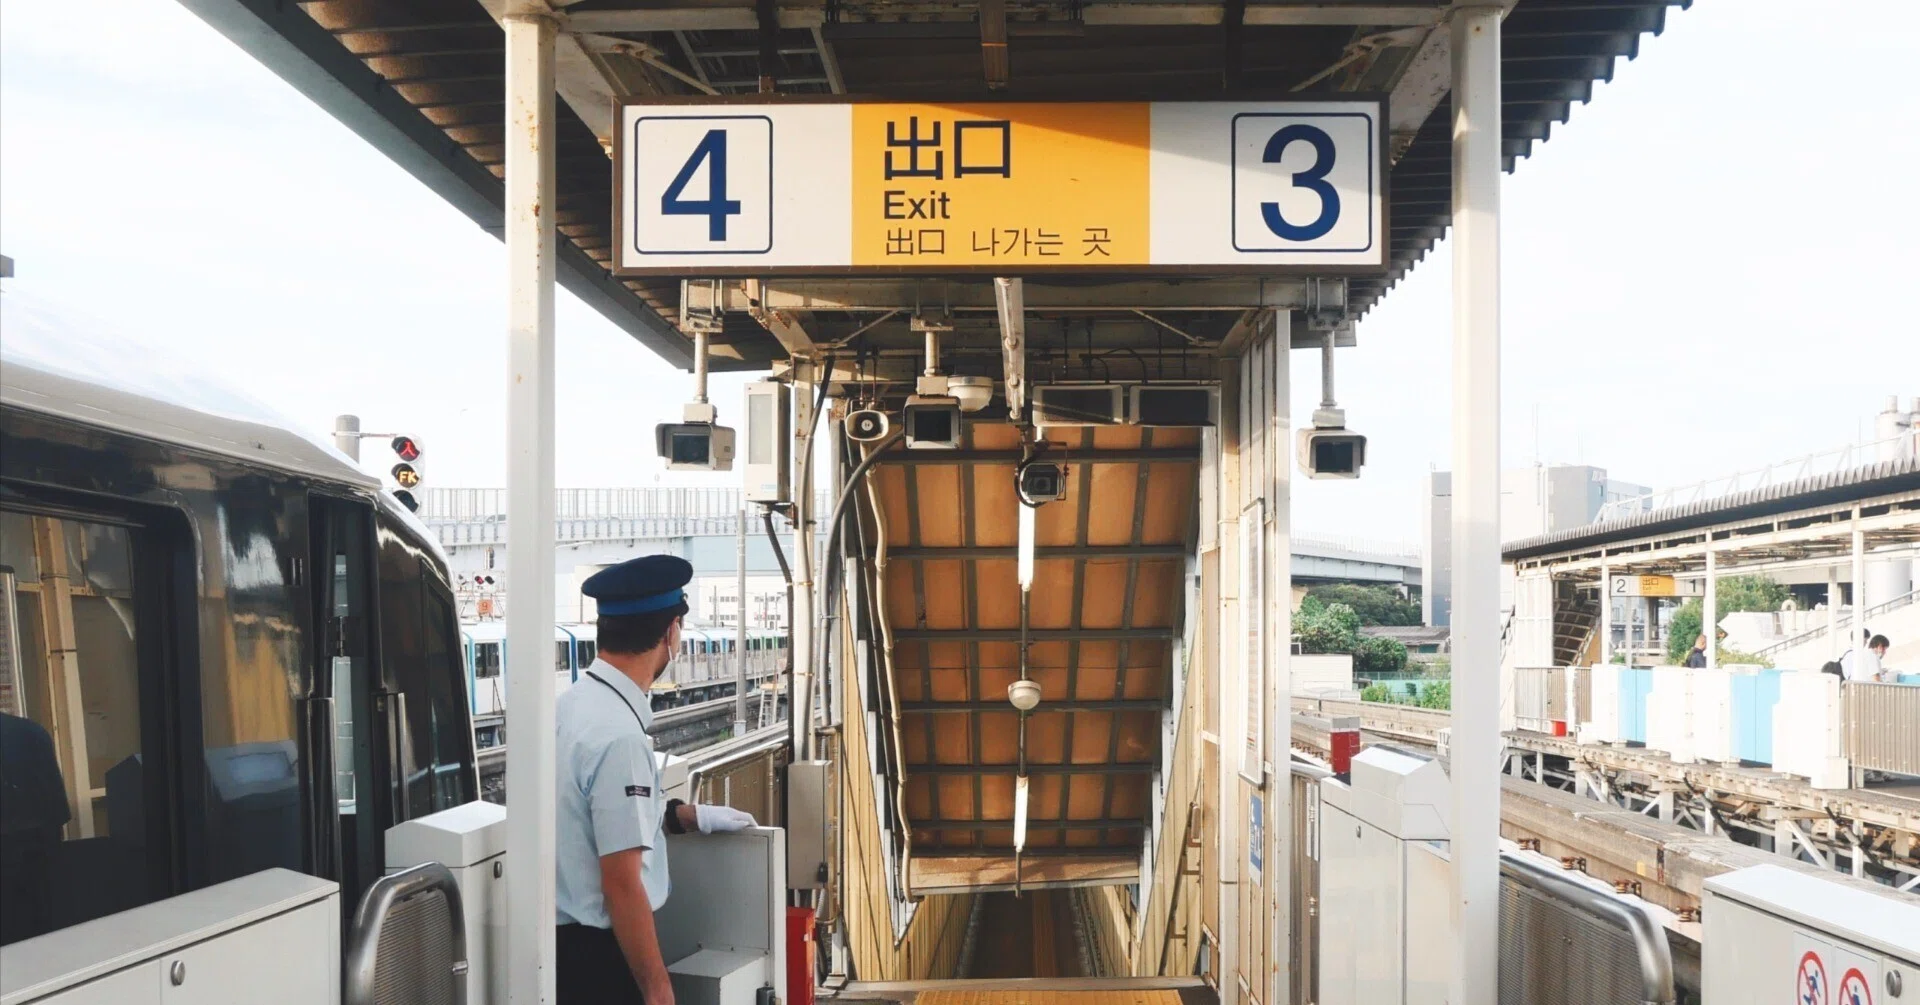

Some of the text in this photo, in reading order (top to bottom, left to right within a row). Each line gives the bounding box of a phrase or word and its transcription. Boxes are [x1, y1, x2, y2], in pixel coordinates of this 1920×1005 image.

[884, 116, 1011, 181] 出口
[661, 130, 741, 242] 4
[1260, 123, 1341, 242] 3
[884, 190, 950, 220] Exit
[886, 227, 945, 256] 出口
[972, 227, 1111, 257] 나가는 곳
[399, 471, 417, 483] FK
[1616, 578, 1627, 593] 2
[1642, 577, 1659, 586] 出口
[1688, 578, 1696, 593] 1
